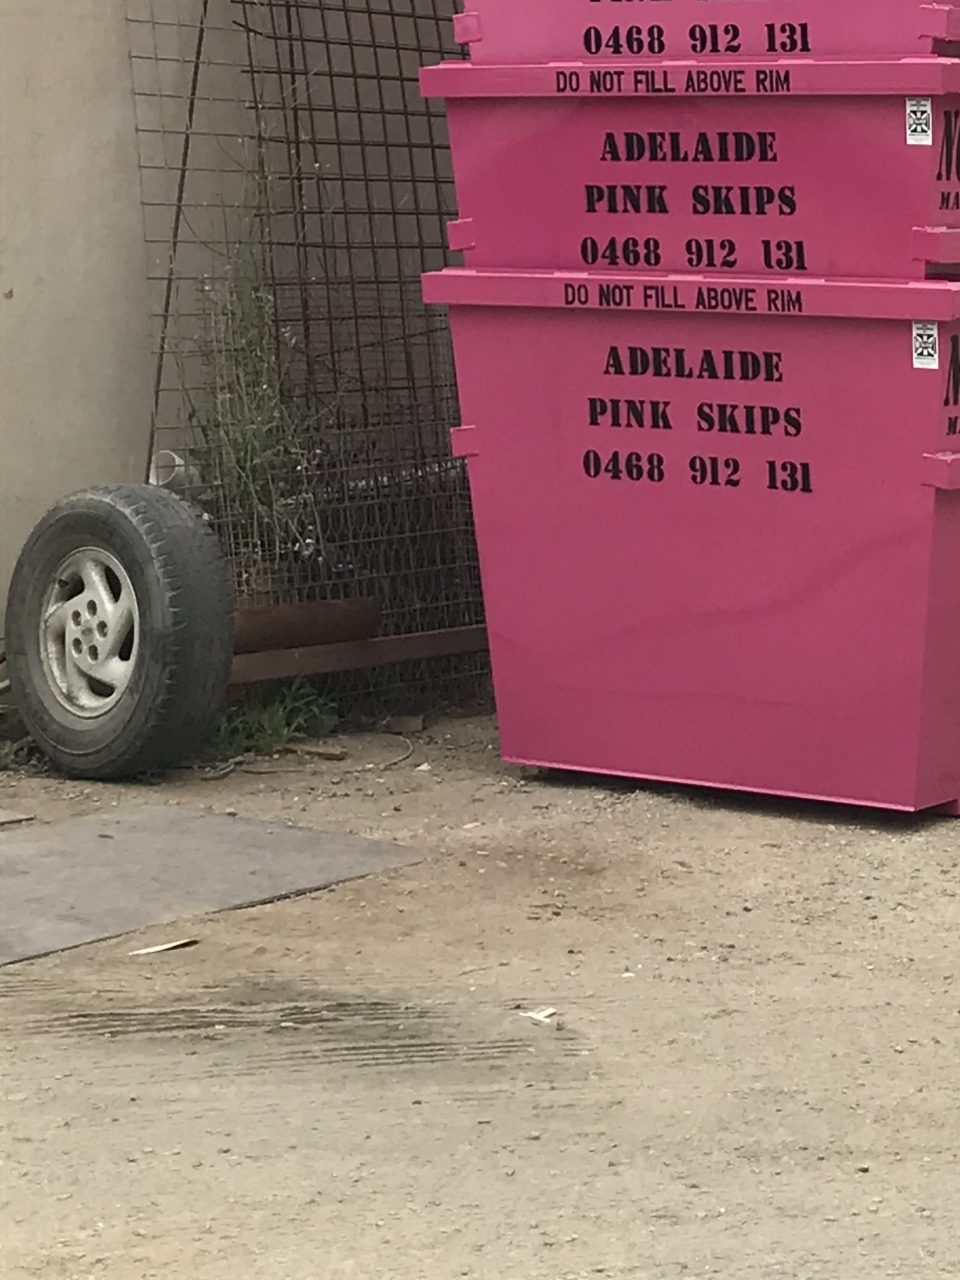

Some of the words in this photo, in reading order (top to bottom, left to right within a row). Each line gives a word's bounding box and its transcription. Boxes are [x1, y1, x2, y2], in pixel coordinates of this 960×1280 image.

[584, 25, 665, 54] 0468
[689, 24, 741, 53] 912
[766, 23, 811, 52] 131
[556, 71, 579, 93] DO
[590, 71, 624, 93] NOT
[634, 71, 676, 93] FILL
[685, 70, 746, 93] ABOVE
[756, 70, 790, 92] RIM
[600, 132, 777, 161] ADELAIDE
[585, 185, 668, 213] PINK
[692, 185, 796, 215] SKIPS
[581, 237, 660, 266] 0468
[686, 239, 737, 268] 912
[762, 240, 807, 270] 131
[565, 284, 588, 305] DO
[599, 284, 633, 306] NOT
[644, 285, 685, 308] FILL
[696, 287, 757, 311] ABOVE
[767, 290, 802, 312] RIM
[604, 346, 782, 382] ADELAIDE
[588, 398, 672, 429] PINK
[697, 403, 801, 437] SKIPS
[583, 450, 664, 482] 0468
[689, 456, 740, 487] 912
[767, 461, 812, 493] 131
